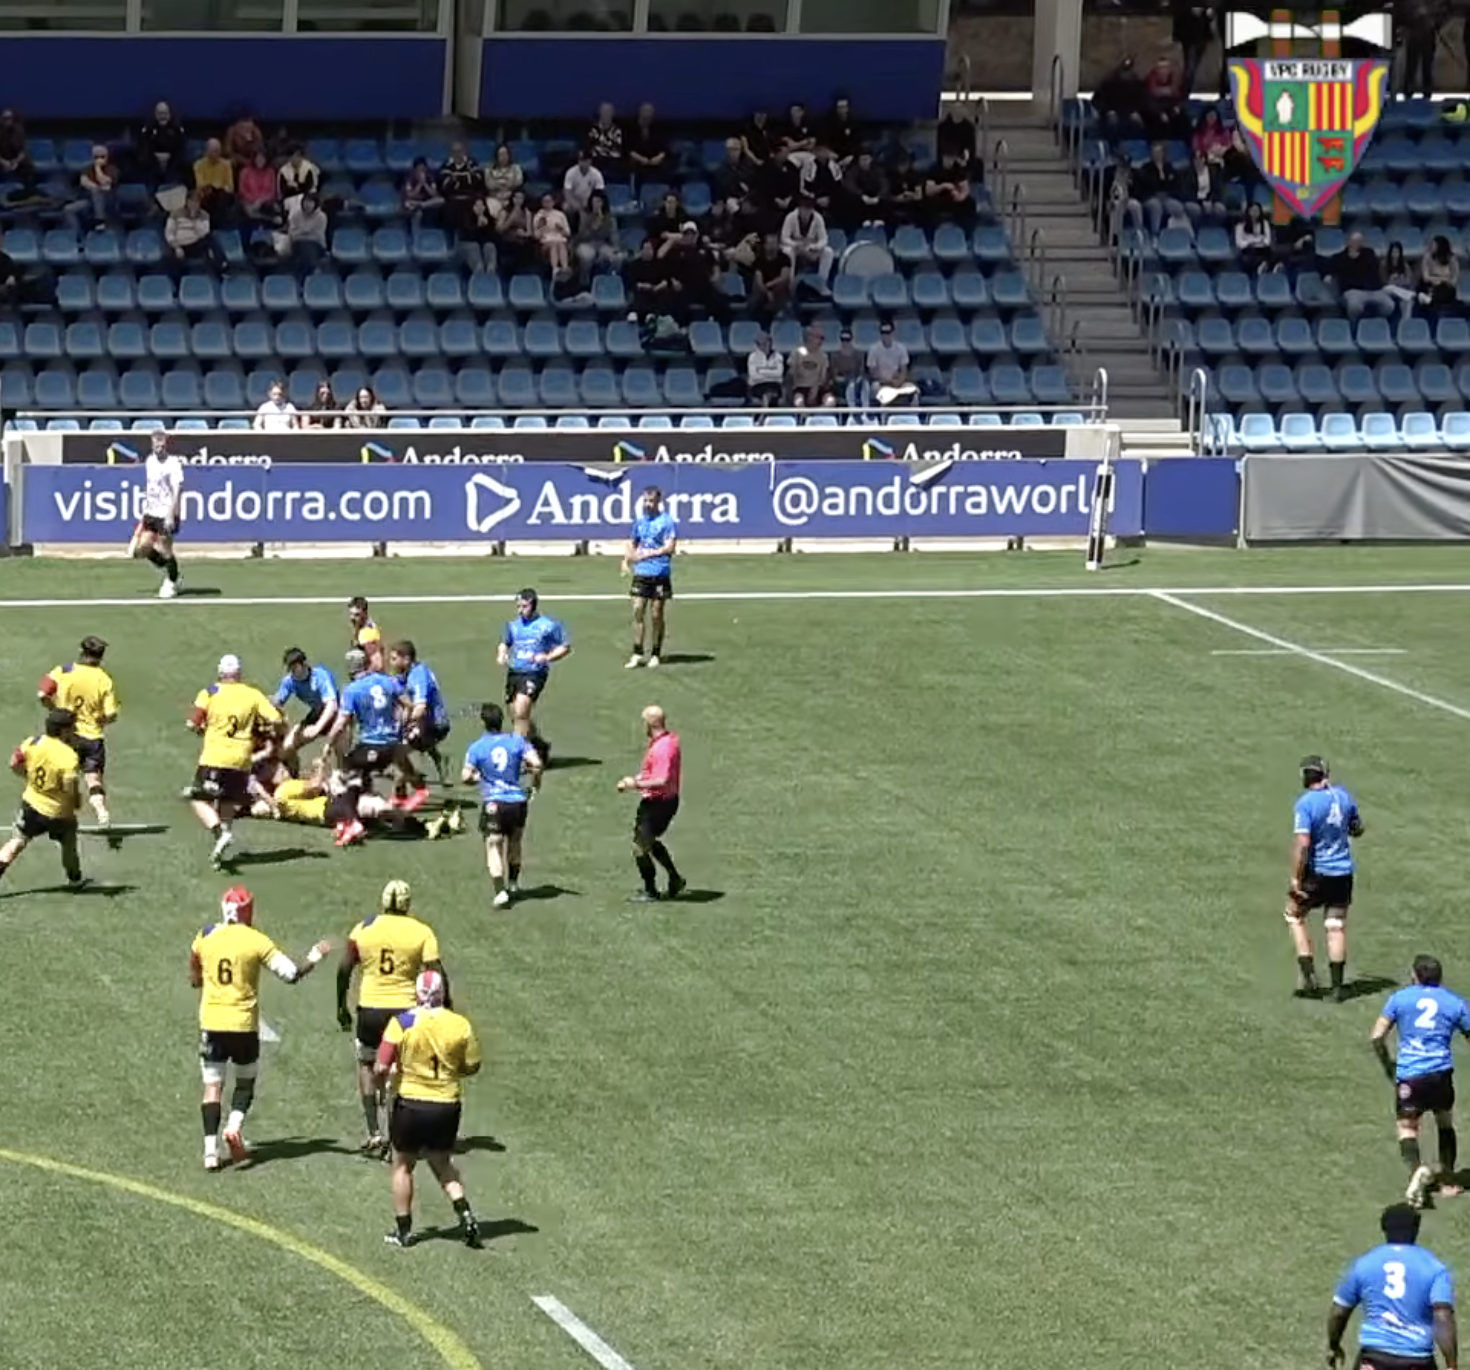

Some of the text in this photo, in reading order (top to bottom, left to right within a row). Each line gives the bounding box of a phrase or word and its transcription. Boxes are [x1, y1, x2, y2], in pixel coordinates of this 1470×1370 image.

[54, 480, 432, 522] visitndorra.com
[370, 684, 387, 709] 8
[491, 745, 508, 772] 9
[1326, 801, 1345, 827] 4
[217, 958, 233, 985] 6
[379, 948, 395, 975] 5
[1413, 997, 1438, 1029] 2
[1382, 1261, 1407, 1299] 3
